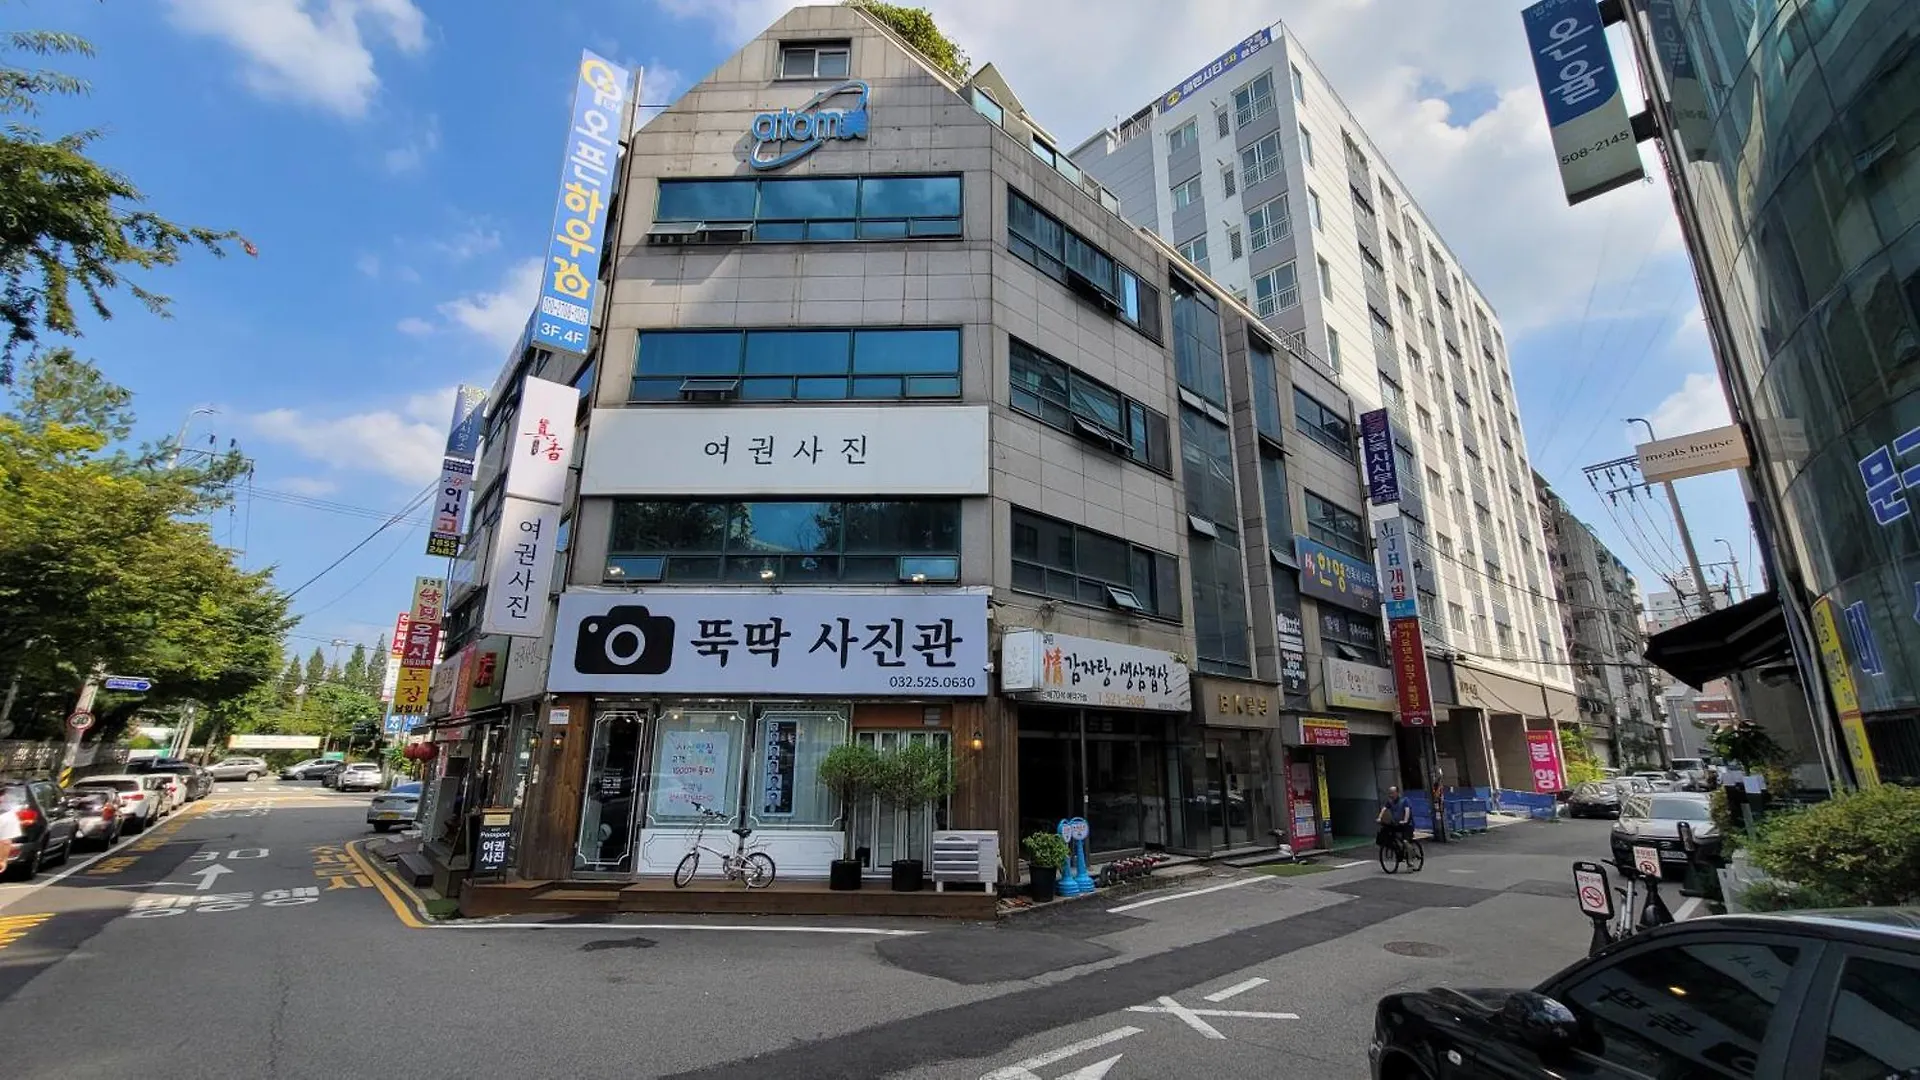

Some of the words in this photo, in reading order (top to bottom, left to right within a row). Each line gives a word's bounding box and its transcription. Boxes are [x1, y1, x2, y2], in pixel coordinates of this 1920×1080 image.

[1561, 131, 1629, 166] 508-2145
[1645, 448, 1686, 462] meals
[1690, 438, 1734, 454] house
[507, 518, 541, 620] 여권사진
[689, 617, 792, 668] 뚝딱
[808, 617, 964, 669] 사진관
[889, 675, 976, 690] 032.525.0630
[481, 851, 504, 863] 사진
[482, 840, 505, 852] 여권
